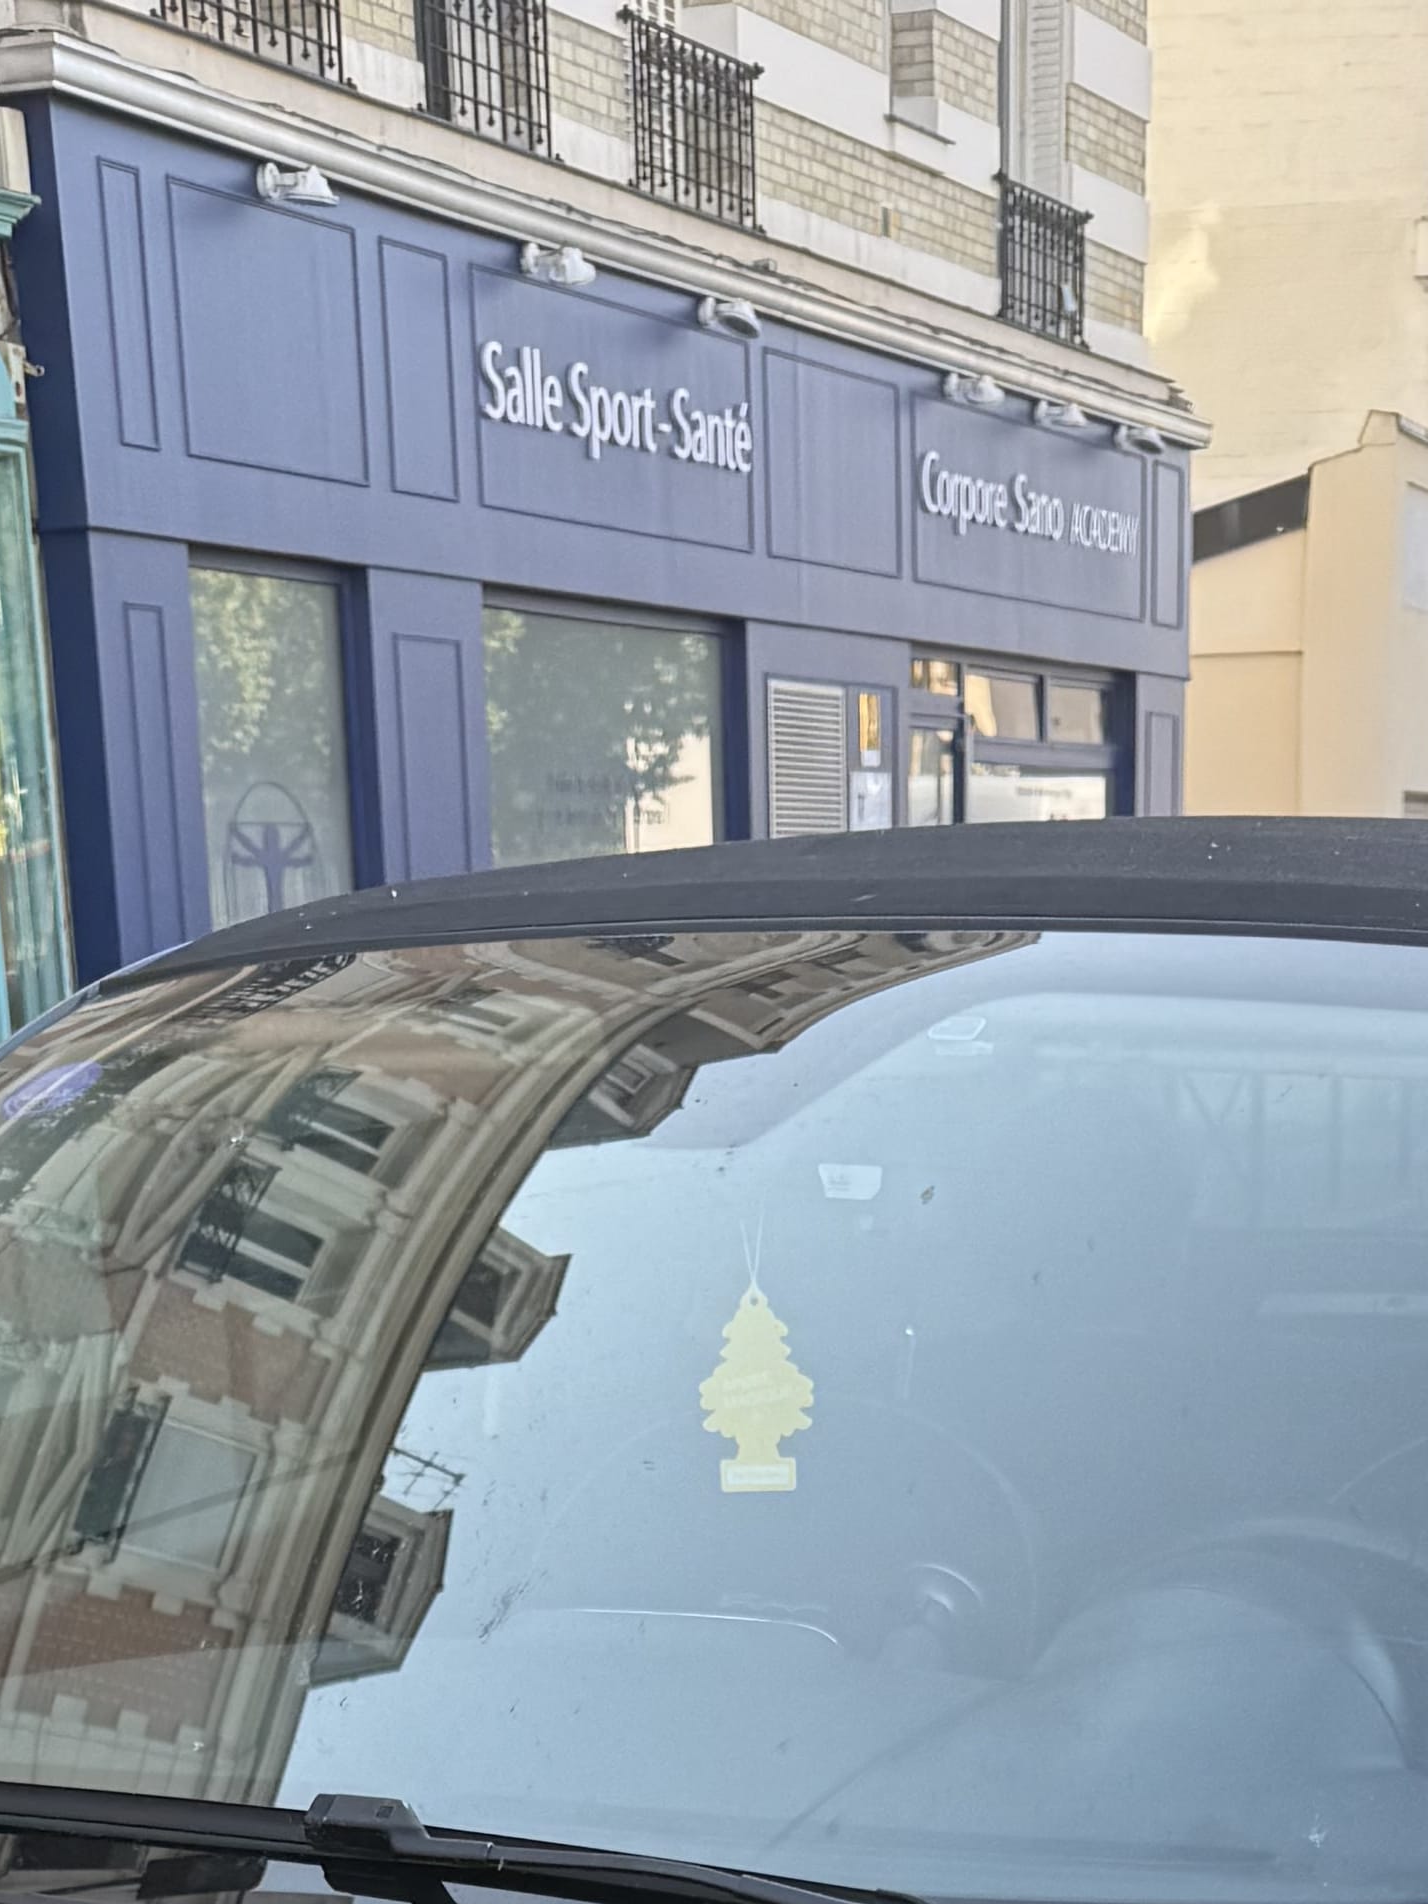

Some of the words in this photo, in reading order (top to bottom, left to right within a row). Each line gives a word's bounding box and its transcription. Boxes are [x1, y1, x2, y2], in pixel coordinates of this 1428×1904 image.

[481, 341, 563, 432] Salle
[922, 450, 1008, 537] Corpore
[1014, 474, 1064, 541] Sano
[1070, 502, 1140, 555] ACADEMY
